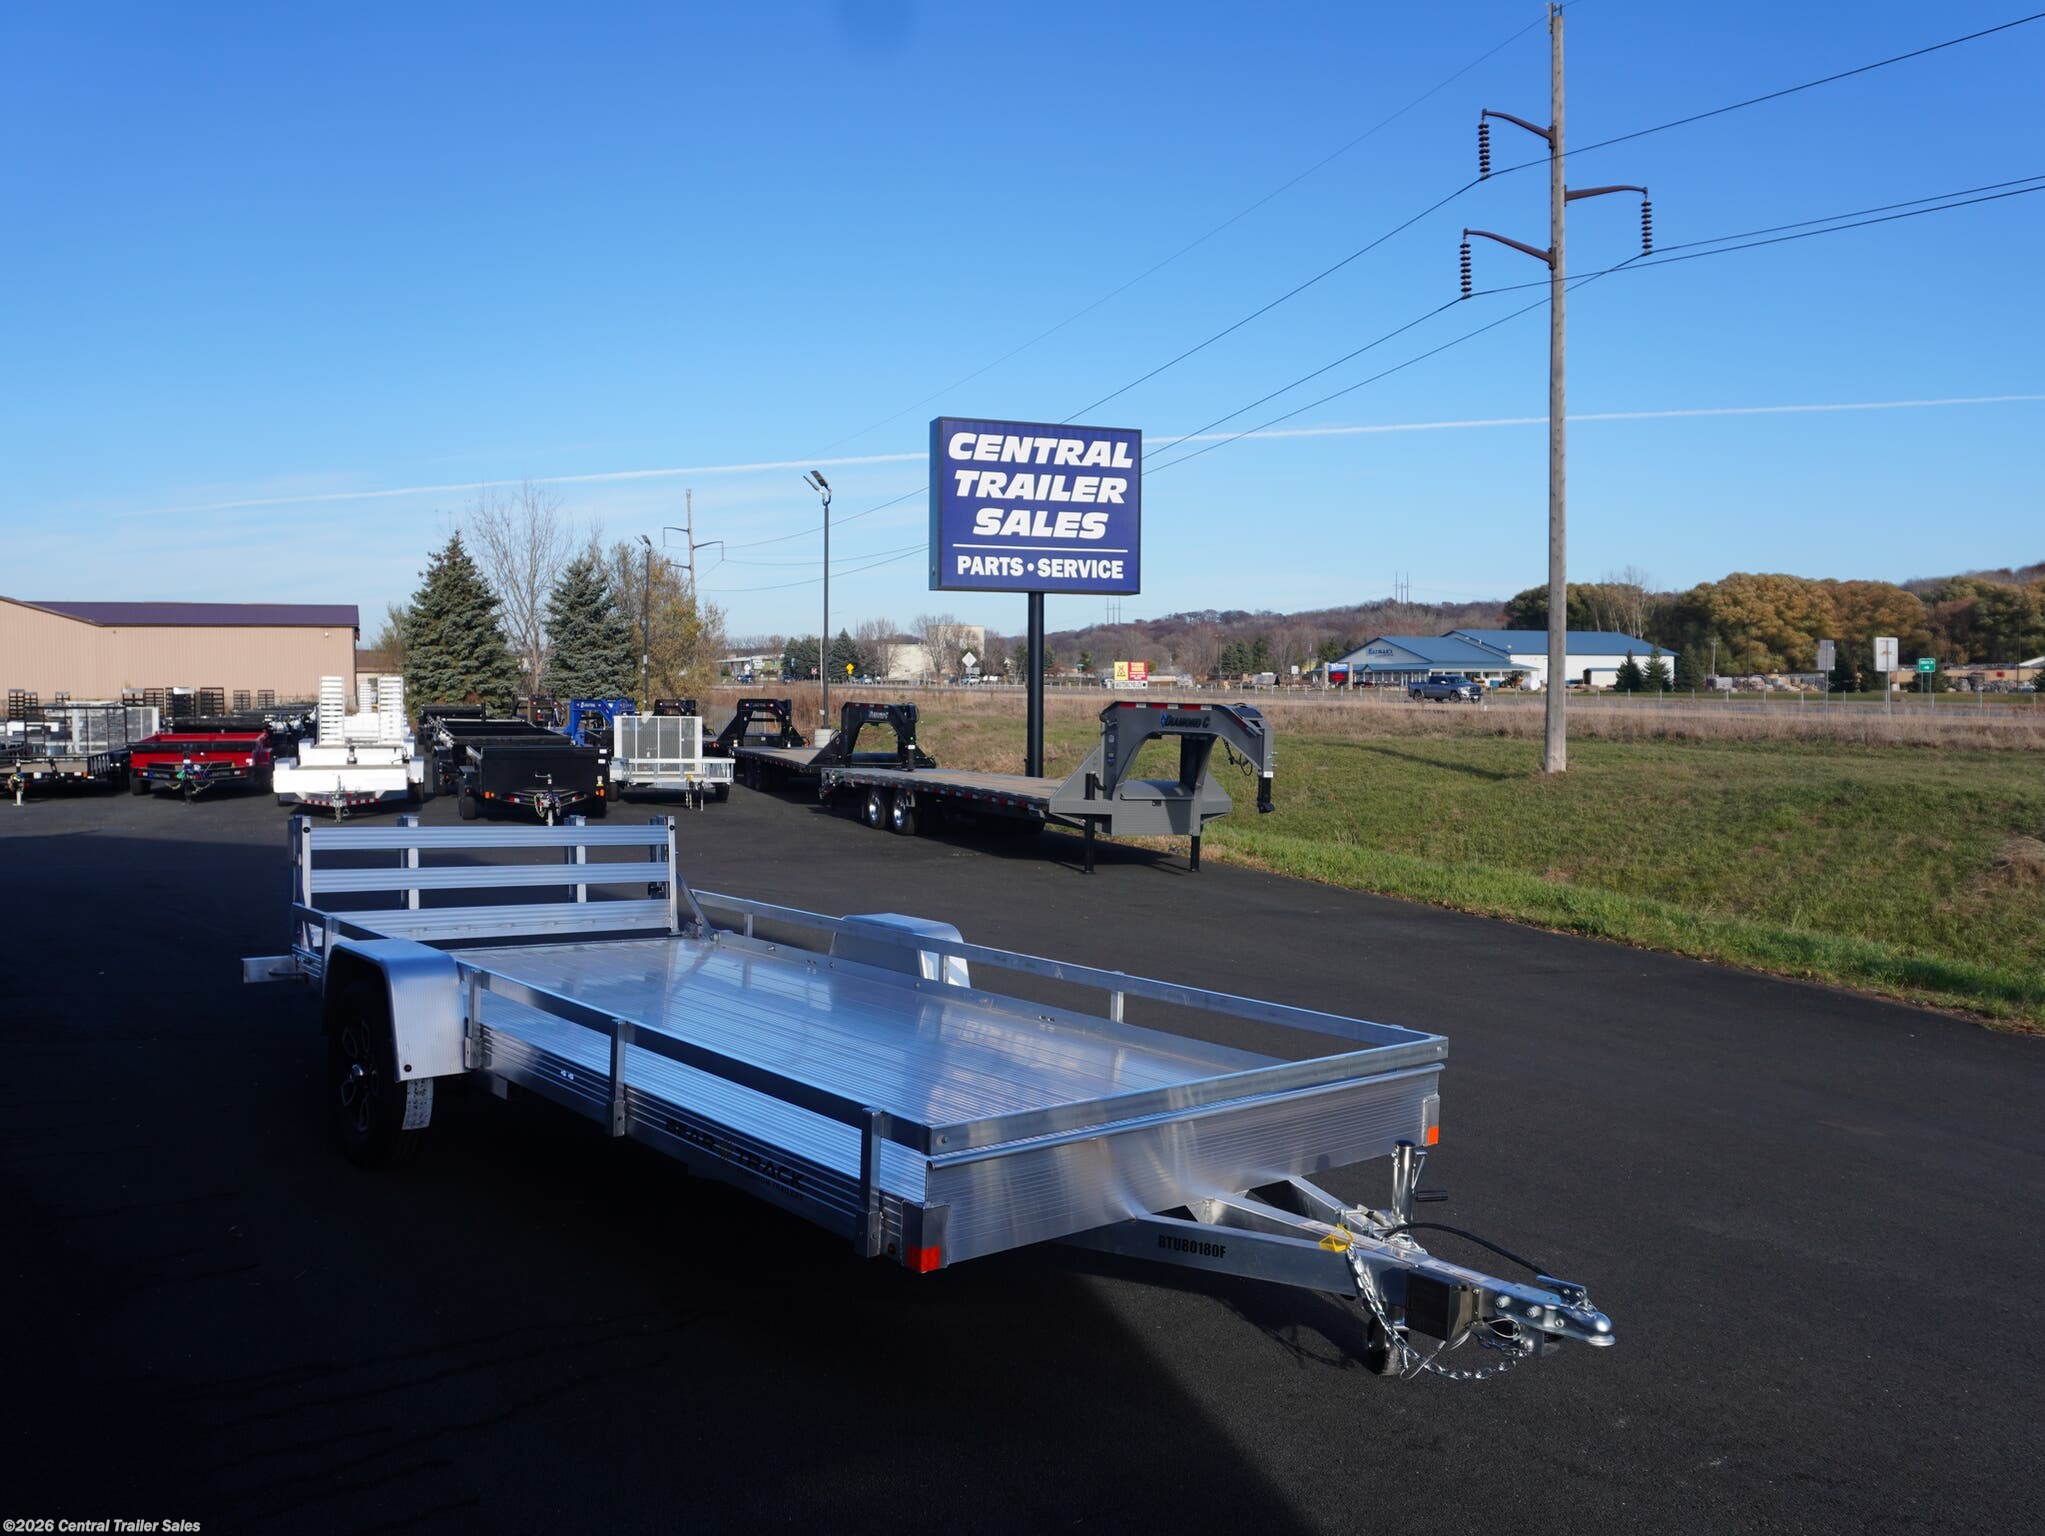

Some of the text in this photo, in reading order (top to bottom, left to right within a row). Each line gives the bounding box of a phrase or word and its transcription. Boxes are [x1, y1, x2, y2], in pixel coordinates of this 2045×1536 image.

[948, 432, 1133, 468] CENTRAL
[954, 470, 1128, 504] TRAILER
[972, 508, 1109, 539] SALES
[957, 556, 1124, 579] PARTS SERVICE
[1159, 1234, 1226, 1259] BTU80180F
